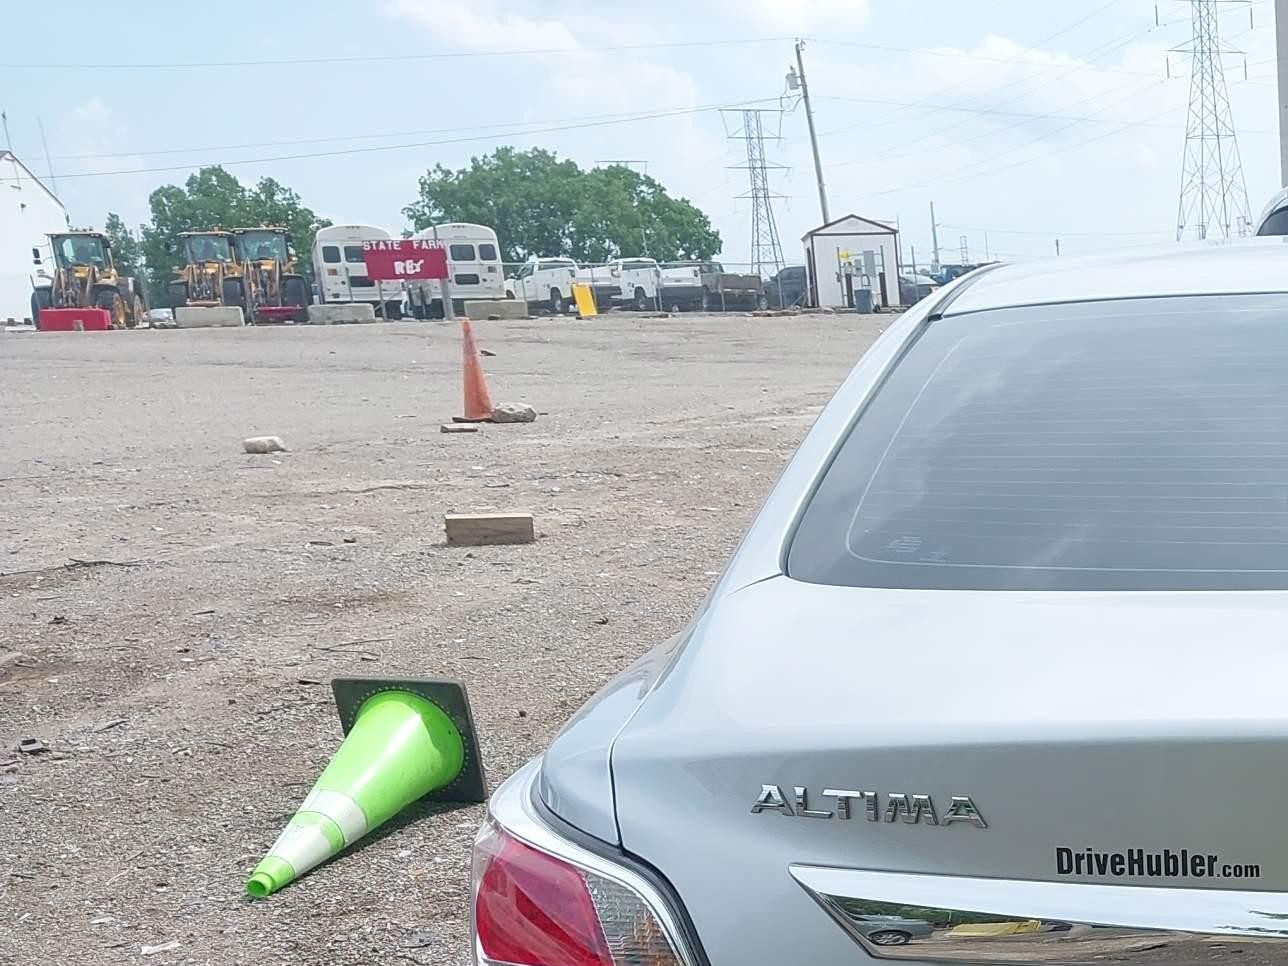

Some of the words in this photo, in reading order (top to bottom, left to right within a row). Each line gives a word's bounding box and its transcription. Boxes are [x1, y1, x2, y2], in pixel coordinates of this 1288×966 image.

[363, 240, 401, 251] STATE
[412, 239, 446, 249] FARM
[750, 784, 988, 828] ALTIMA
[1056, 847, 1260, 877] DriveHubler.com
